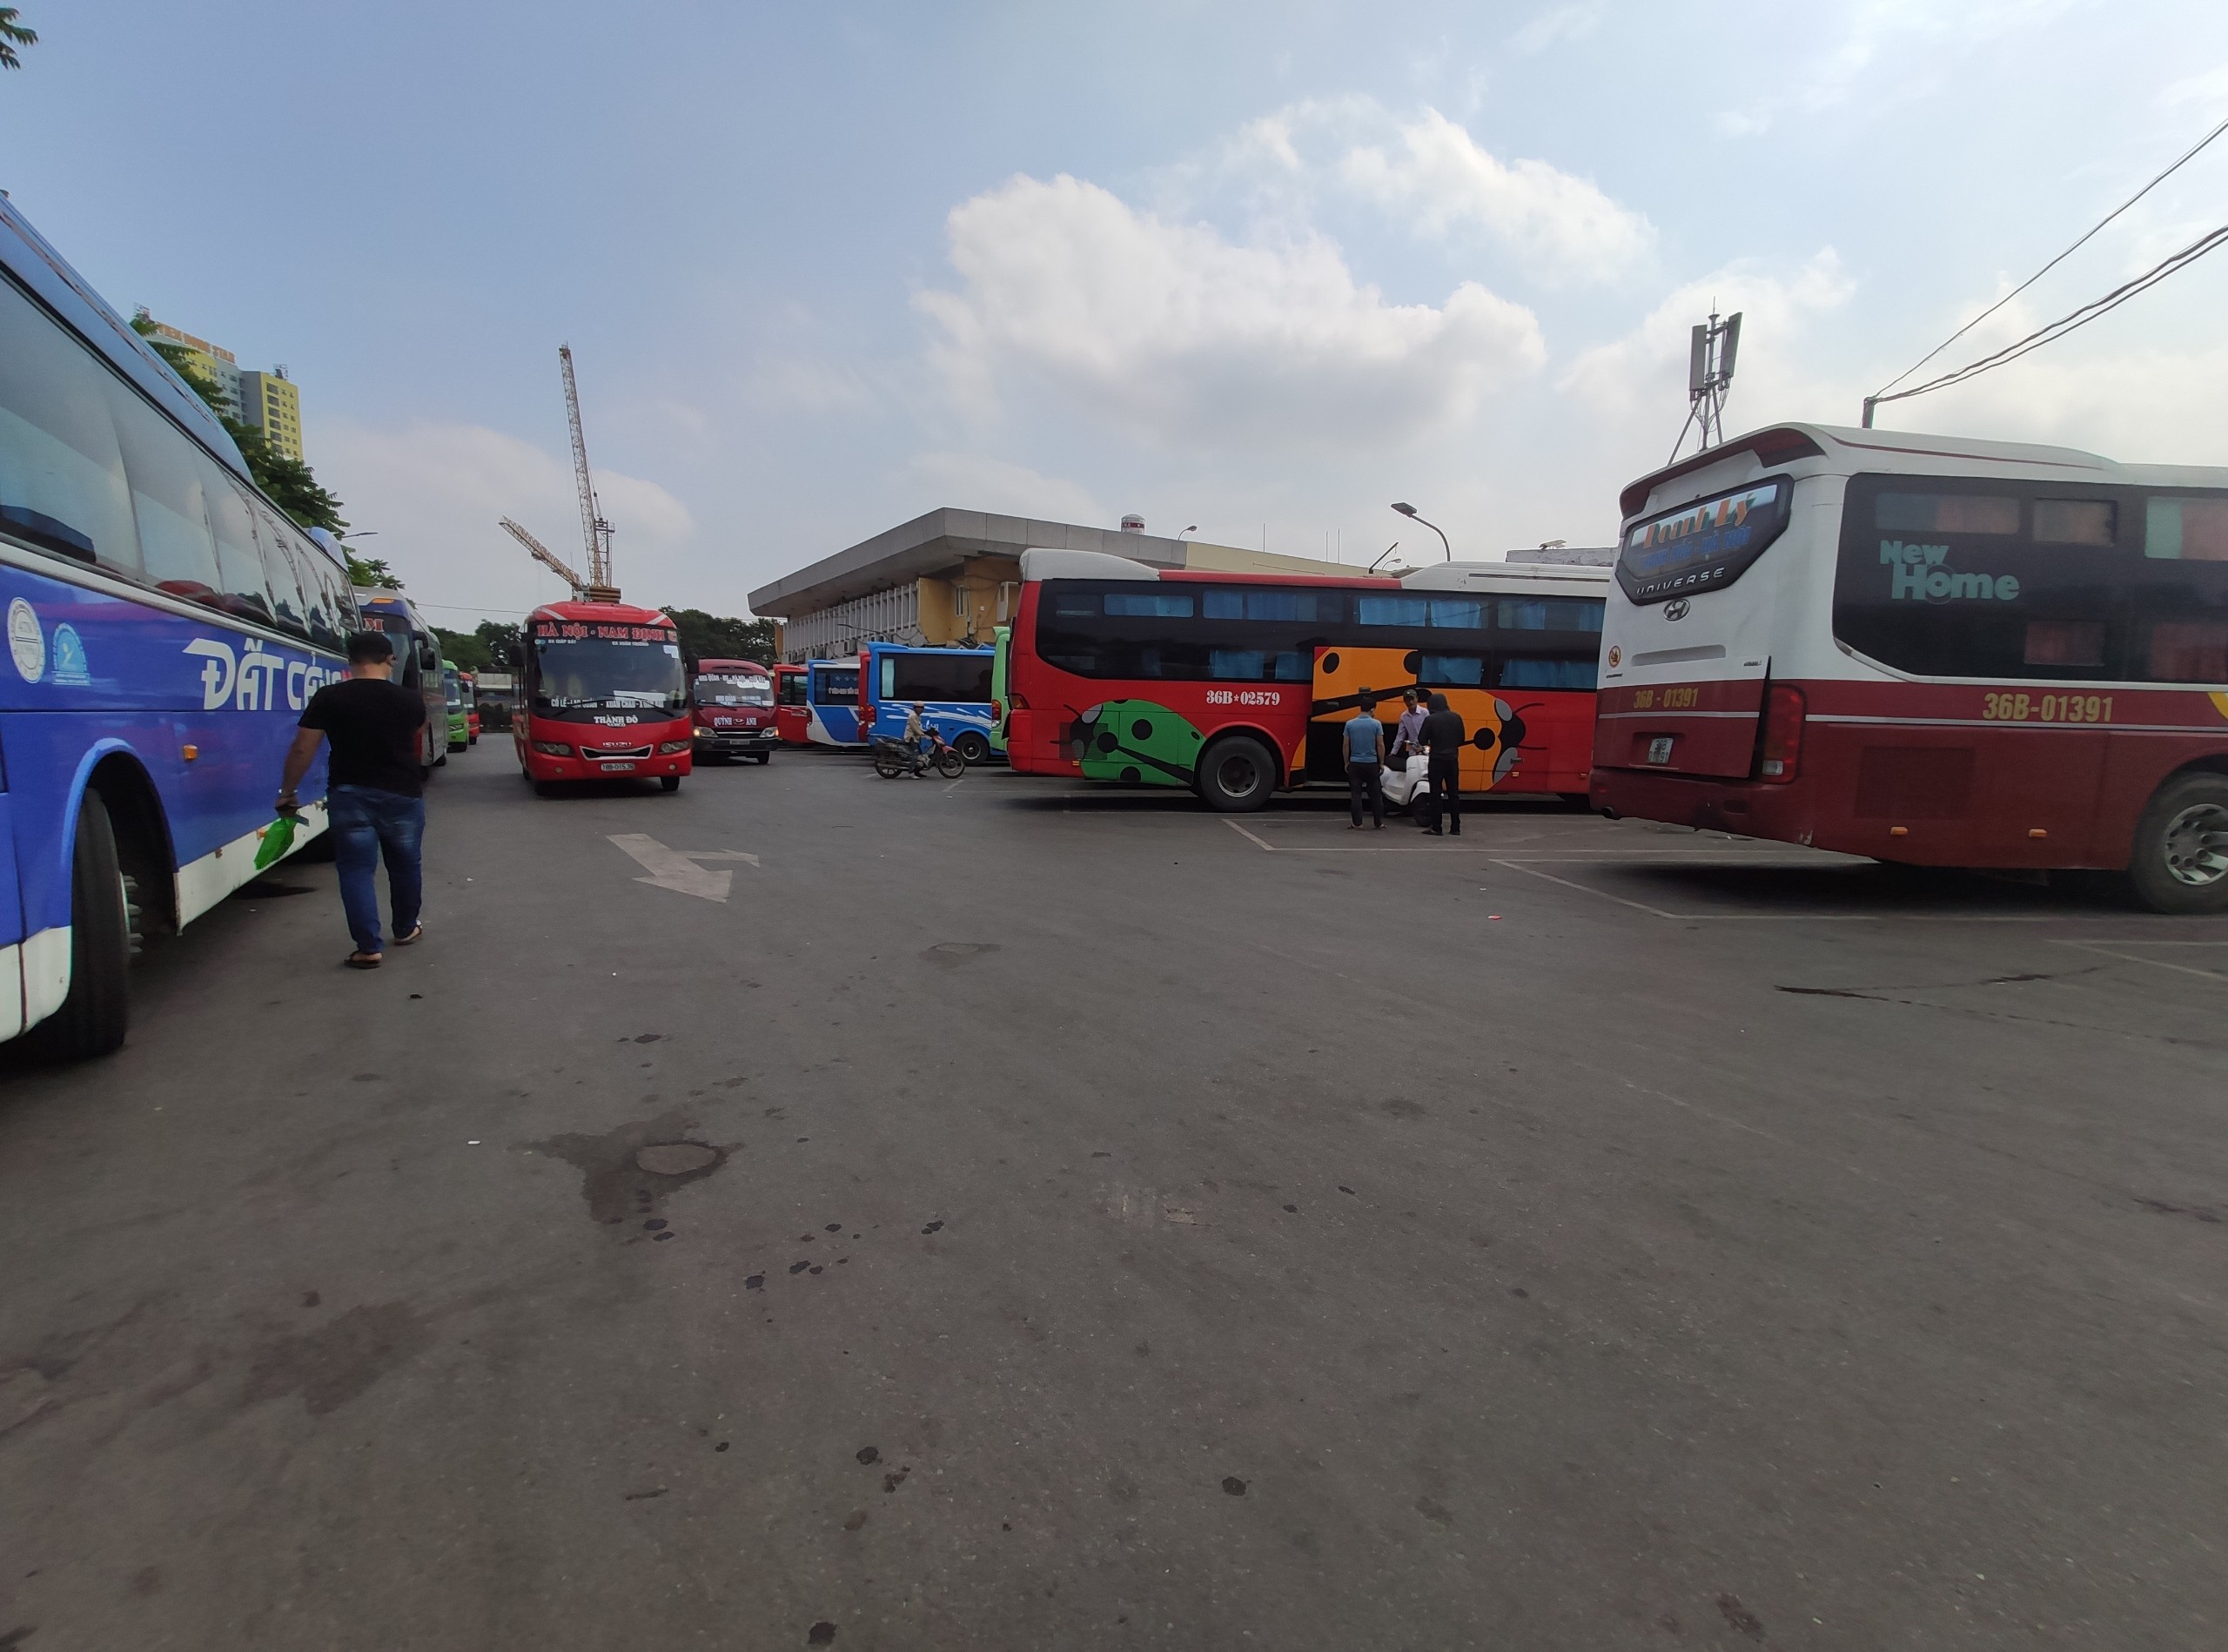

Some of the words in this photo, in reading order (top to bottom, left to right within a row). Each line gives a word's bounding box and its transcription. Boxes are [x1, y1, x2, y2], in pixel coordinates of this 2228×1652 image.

[1880, 540, 1950, 565] New
[1637, 567, 1725, 594] UNIVERSE
[1891, 564, 2020, 601] Home
[598, 626, 629, 640] NAM
[1983, 693, 2113, 722] 36B-01391
